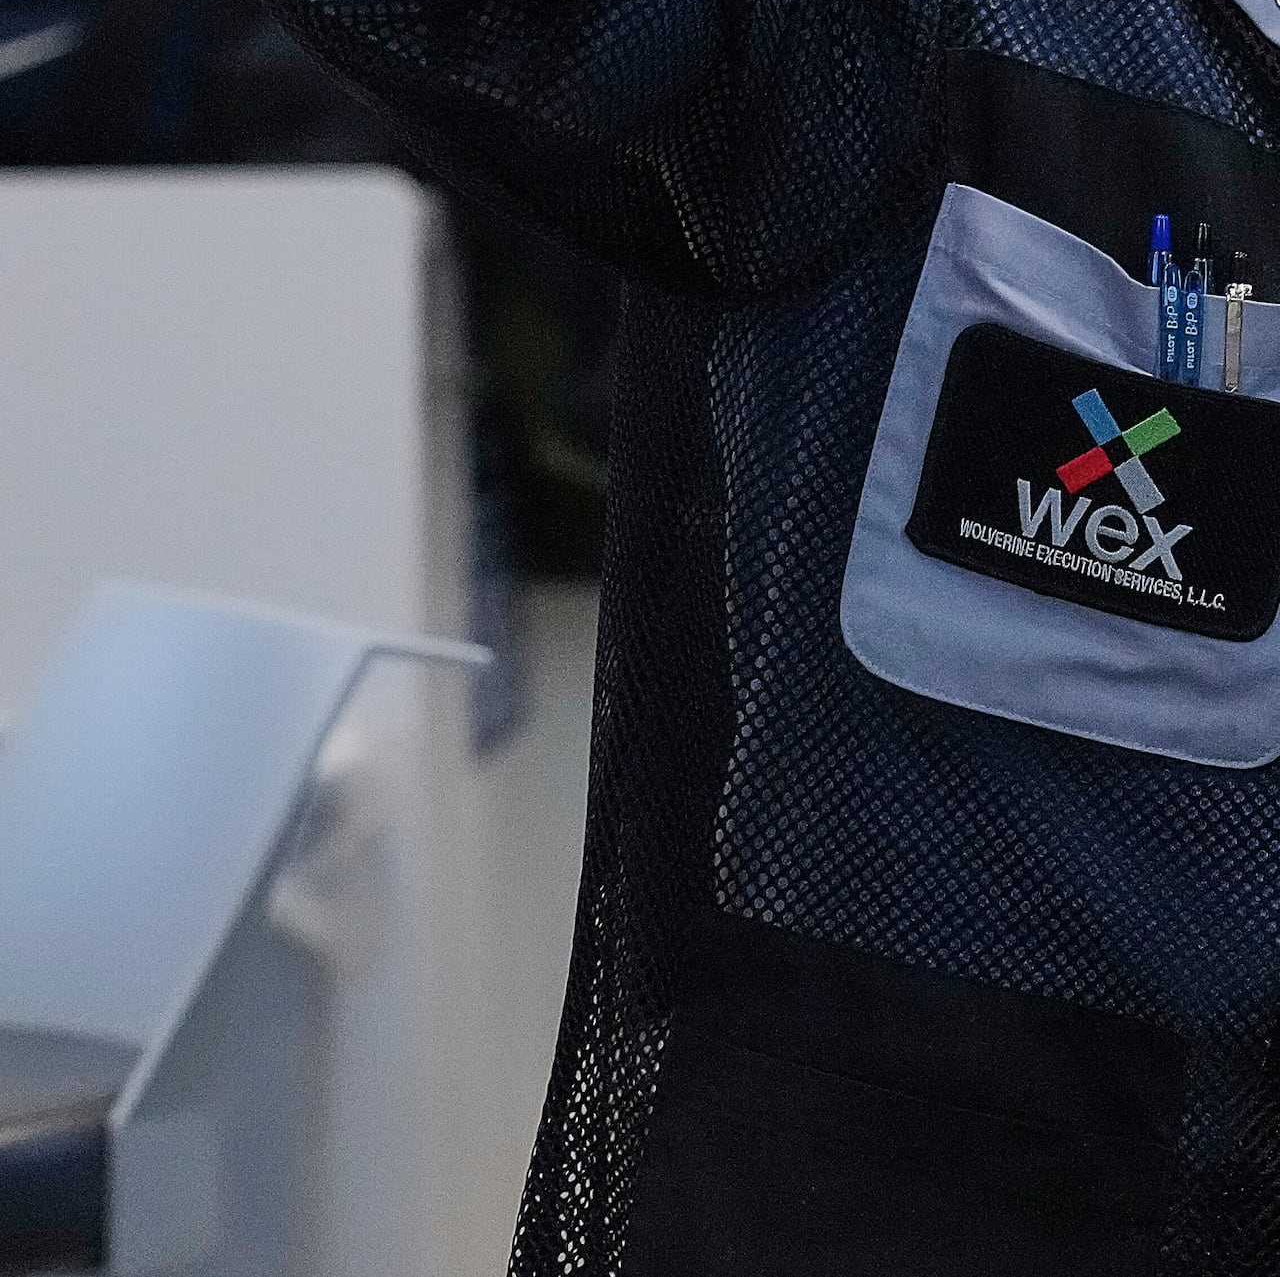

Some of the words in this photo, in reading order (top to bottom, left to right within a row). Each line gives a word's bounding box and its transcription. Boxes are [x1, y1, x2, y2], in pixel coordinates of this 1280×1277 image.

[1167, 334, 1175, 362] PILOT
[1187, 340, 1195, 368] PILOT
[1016, 477, 1194, 581] wex
[959, 517, 1036, 558] WOLVERINE
[1035, 544, 1113, 583] EXECUTION
[1112, 567, 1184, 605] SERVICES,
